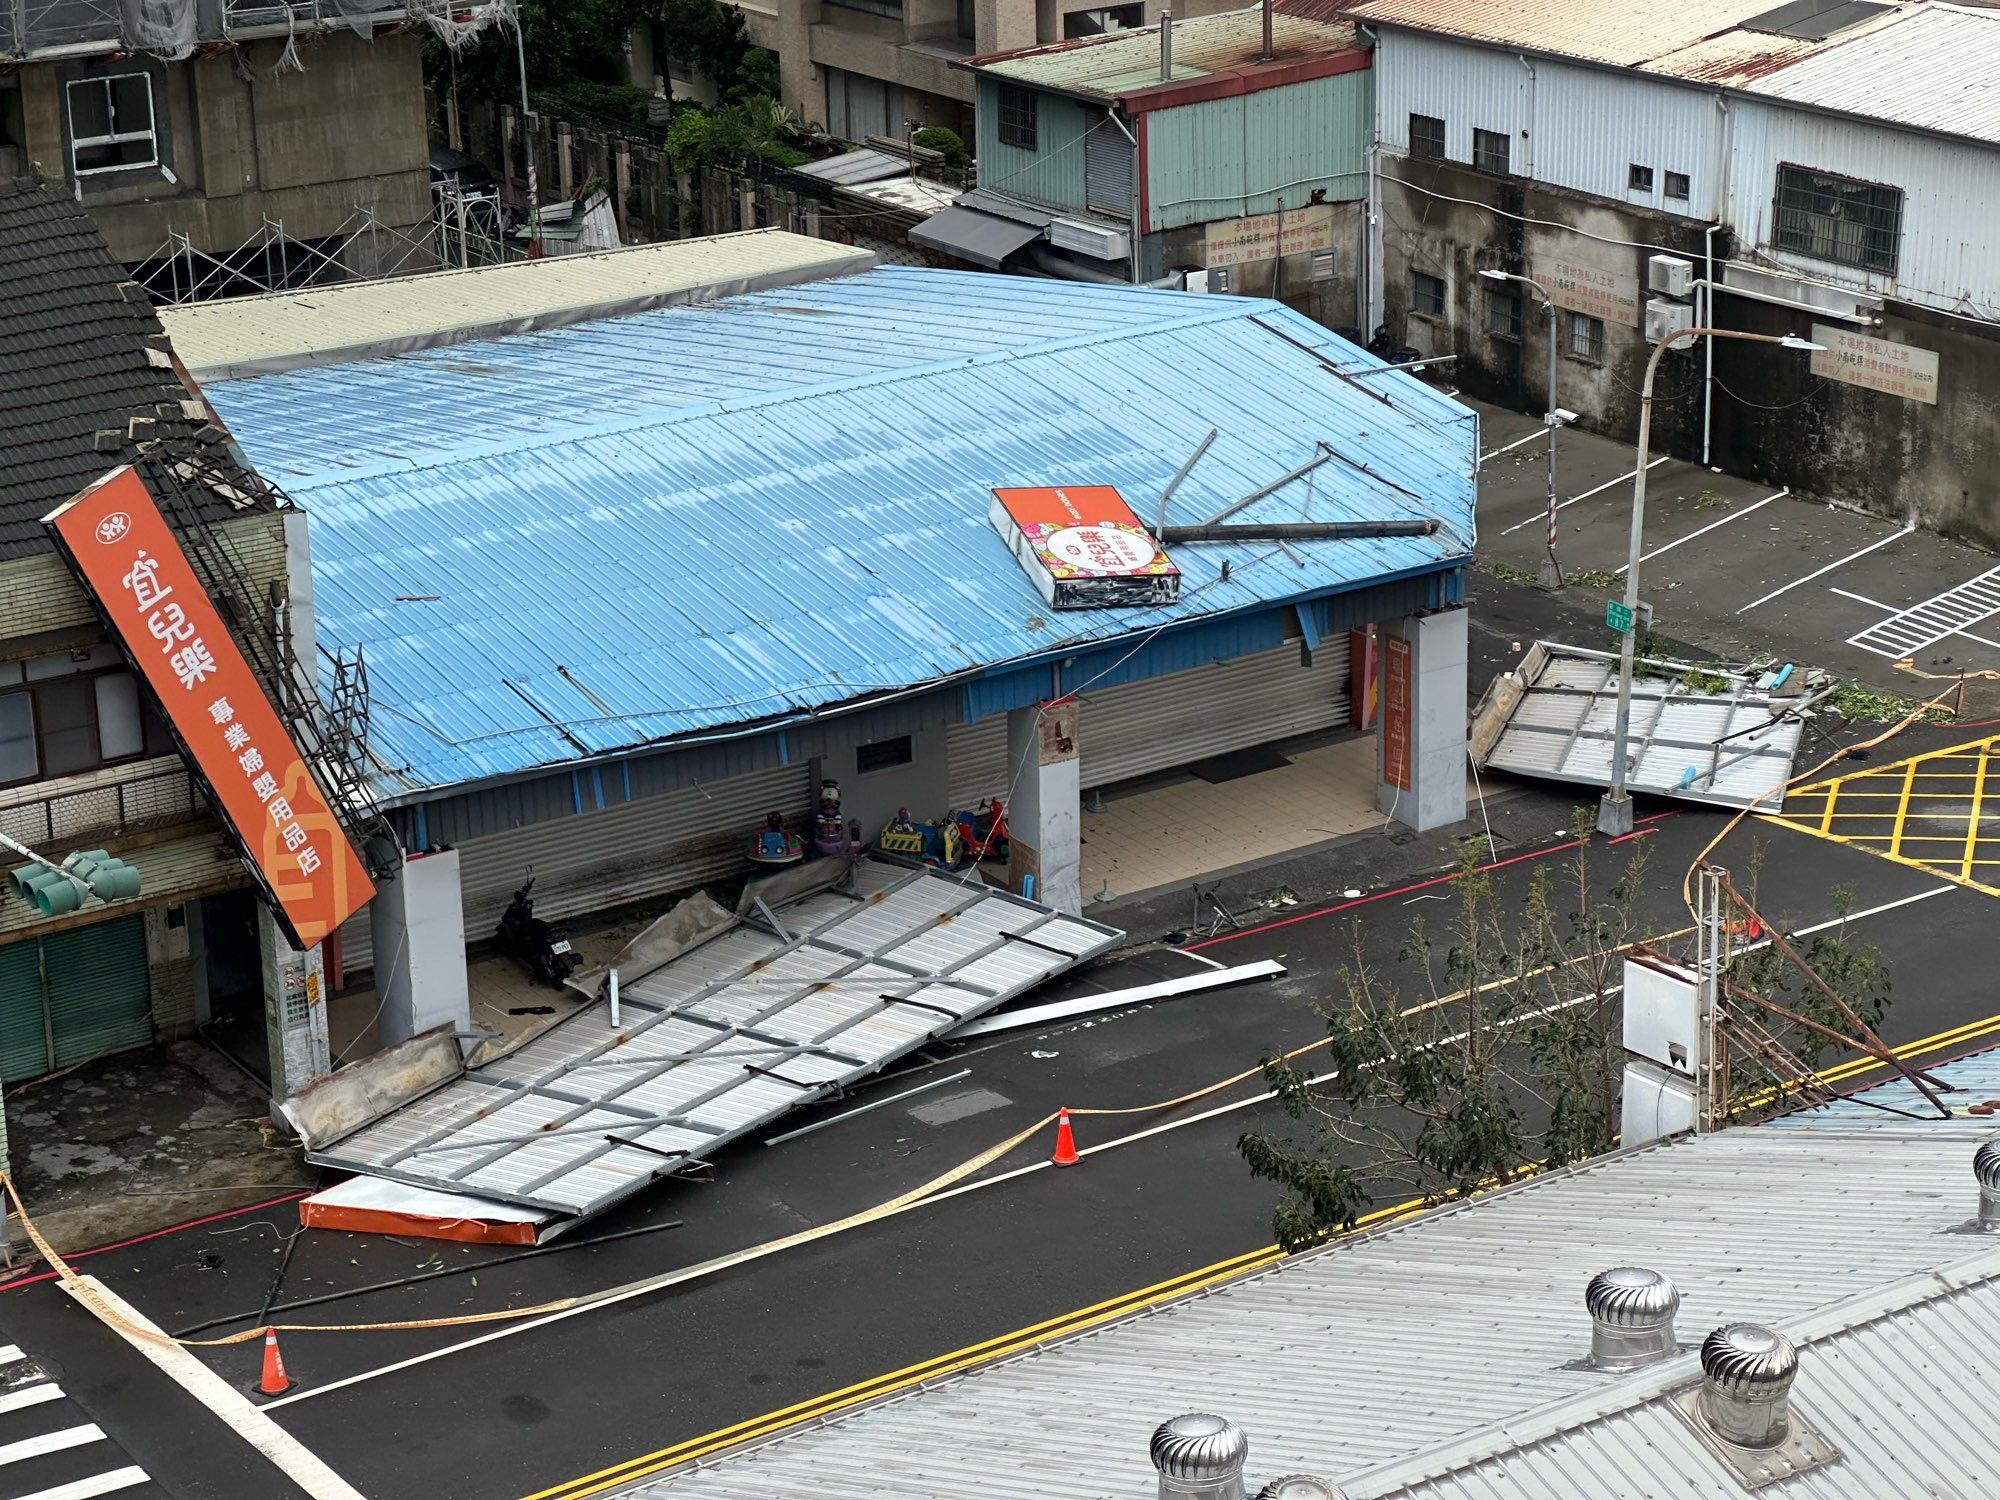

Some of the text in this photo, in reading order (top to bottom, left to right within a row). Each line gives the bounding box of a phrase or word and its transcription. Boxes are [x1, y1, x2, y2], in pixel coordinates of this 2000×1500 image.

[1076, 530, 1125, 567] 宜兒樂
[123, 550, 218, 690] 宜兒樂
[208, 696, 322, 877] 專業婦嬰用品店
